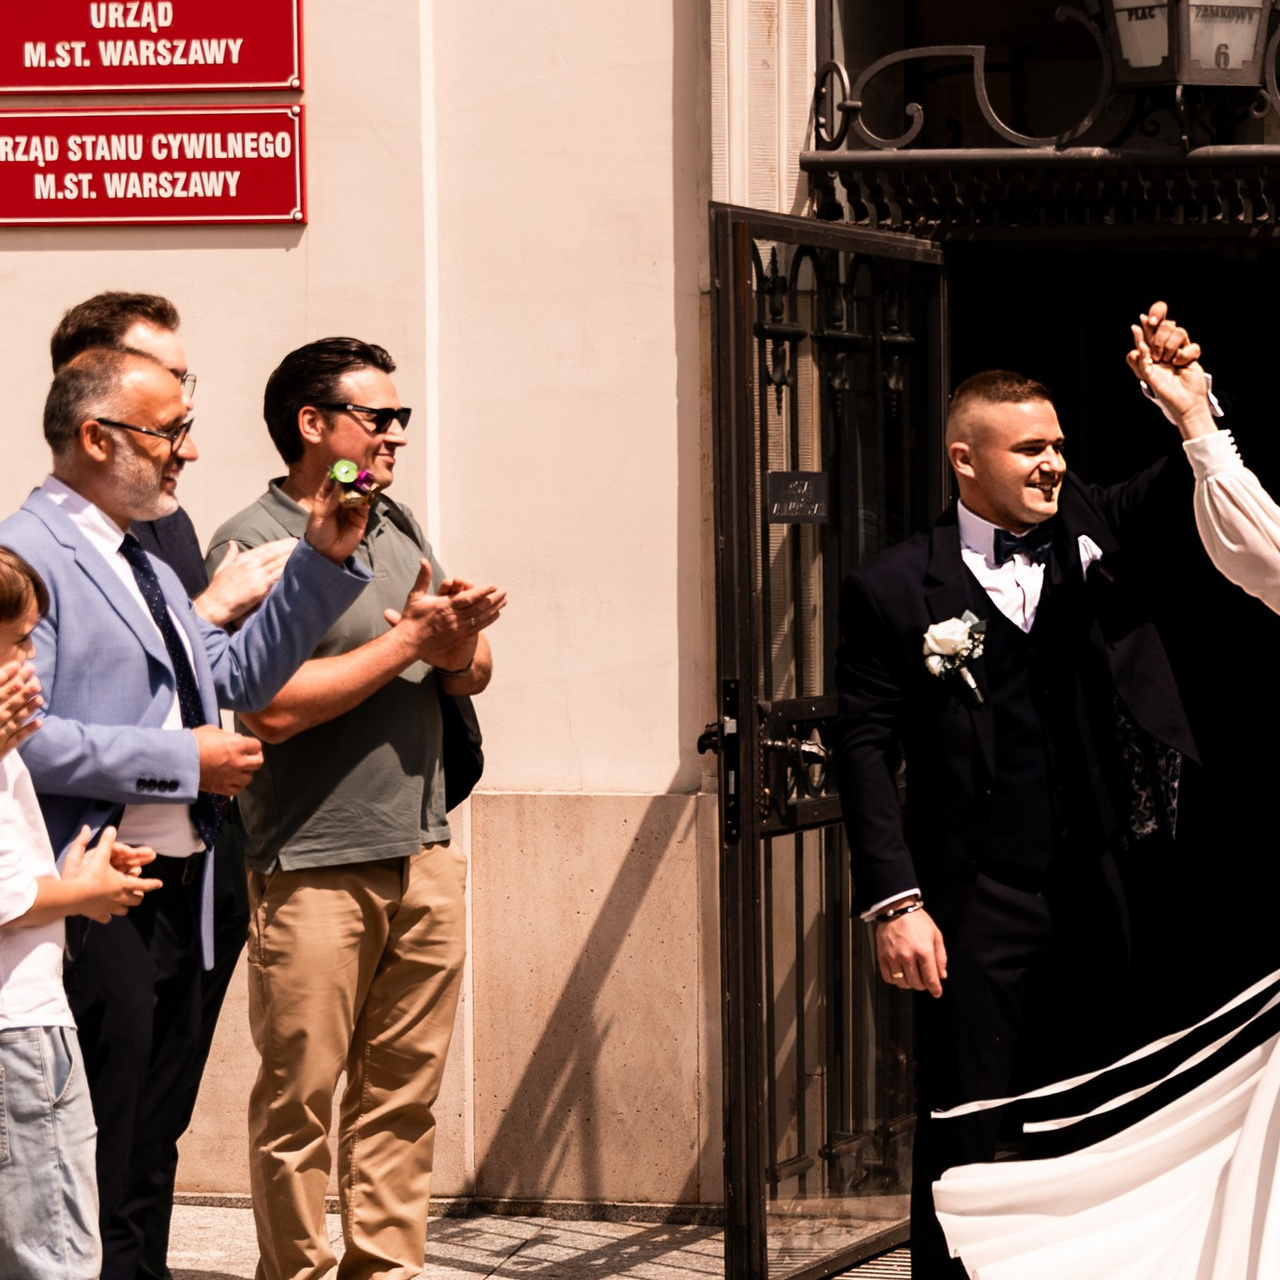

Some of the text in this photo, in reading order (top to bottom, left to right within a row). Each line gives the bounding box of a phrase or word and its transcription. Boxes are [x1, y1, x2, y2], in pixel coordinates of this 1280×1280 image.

[90, 1, 174, 34] URZĄD
[23, 38, 244, 68] M.ST. WARSZAWY
[1214, 43, 1231, 71] 6
[0, 131, 292, 168] RZĄD STANU CYWILNEGO
[34, 171, 241, 200] M.ST. WARSZAWY
